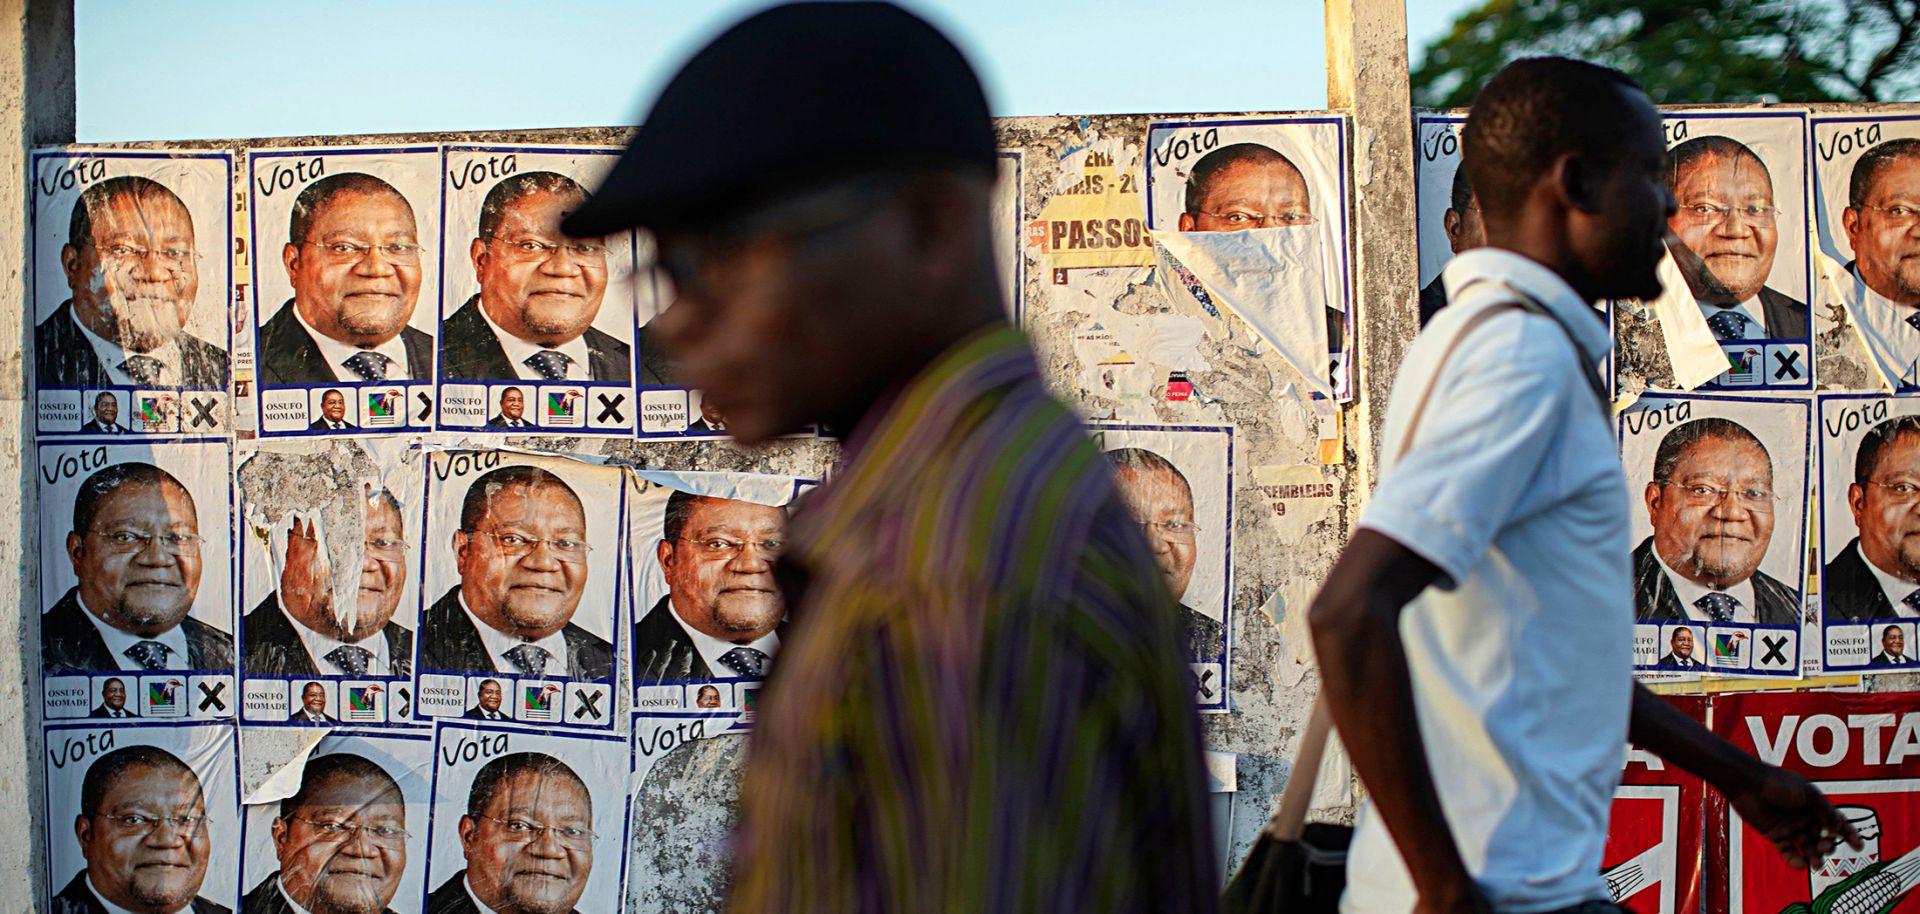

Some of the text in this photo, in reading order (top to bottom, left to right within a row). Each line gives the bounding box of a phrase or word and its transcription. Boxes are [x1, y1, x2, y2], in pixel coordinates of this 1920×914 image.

[1663, 120, 1688, 145] ta
[1153, 128, 1220, 167] Vota
[1423, 130, 1458, 162] Vo
[1818, 123, 1882, 162] Vota
[40, 157, 106, 196] Vota
[258, 157, 324, 196] Vota
[449, 154, 518, 191] Vota
[1051, 218, 1153, 249] PASSOS
[39, 402, 77, 411] OSSUFO
[265, 402, 304, 411] OSSUFO
[444, 397, 483, 406] OSSUFO
[442, 407, 487, 416] MOMADE
[645, 403, 682, 411] OSSUFO
[38, 412, 81, 422] MOMADE
[263, 411, 308, 421] MOMADE
[643, 412, 687, 422] MOMADE
[1626, 401, 1691, 435] Vota
[1825, 400, 1888, 438] Vota
[41, 446, 108, 484] Vota
[433, 450, 500, 482] Vota
[1830, 638, 1865, 646] OSSUFO
[1828, 647, 1869, 656] MOMADE
[48, 689, 85, 698] OSSUFO
[247, 692, 284, 701] OSSUFO
[422, 687, 460, 697] OSSUFO
[46, 698, 90, 708] MOMADE
[245, 701, 288, 711] MOMADE
[420, 697, 464, 707] MOMADE
[642, 698, 679, 707] OSSUFO
[638, 719, 706, 757] Vota
[1744, 713, 1920, 767] VOTA
[50, 728, 116, 770] Vota
[442, 732, 509, 768] Vota
